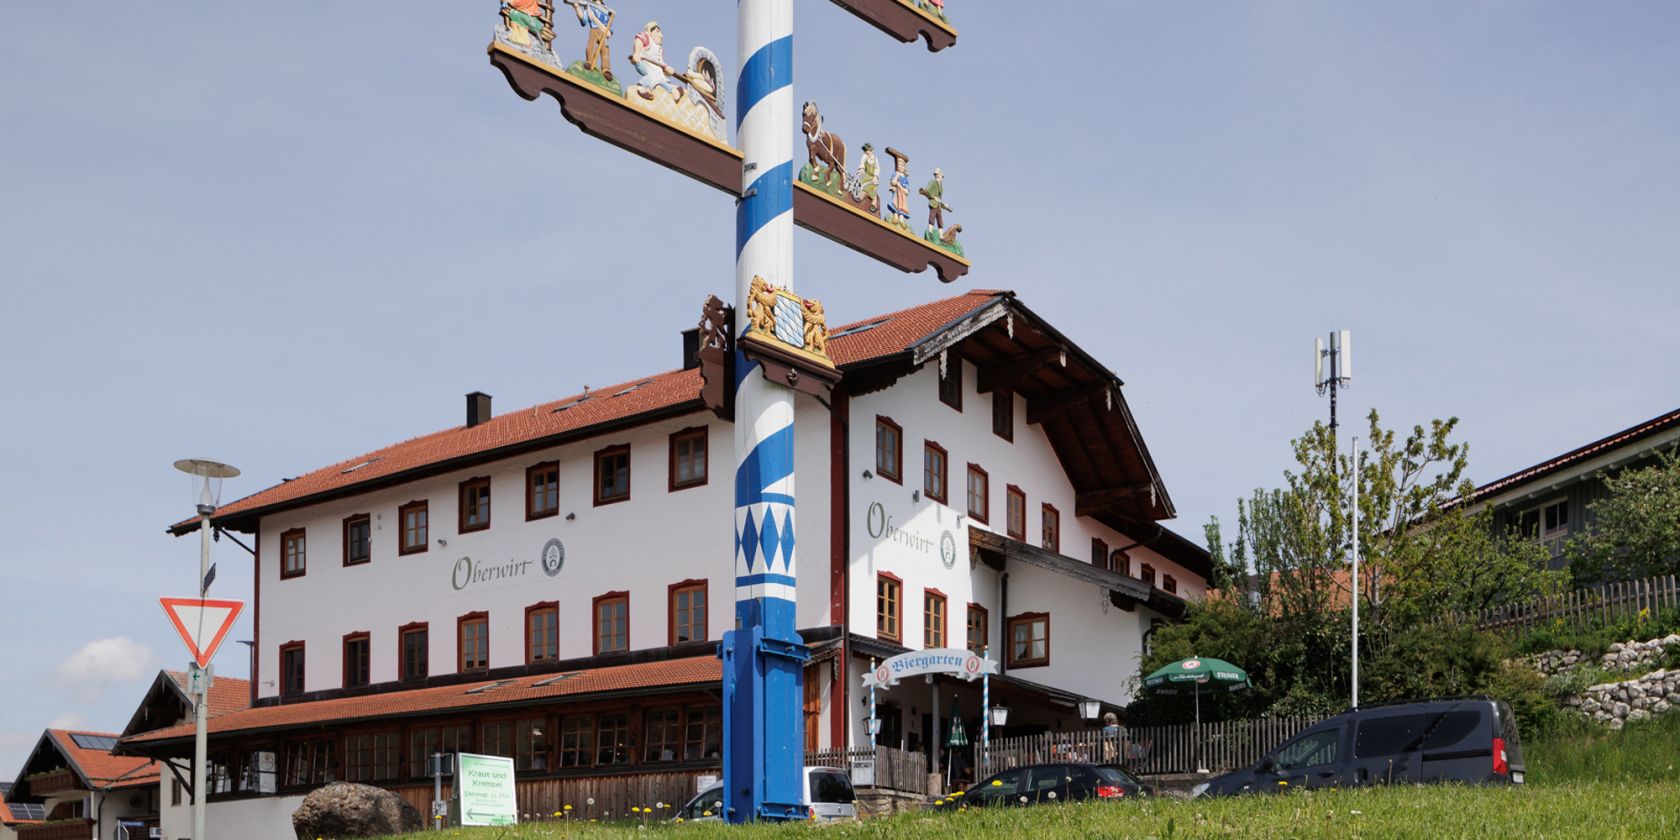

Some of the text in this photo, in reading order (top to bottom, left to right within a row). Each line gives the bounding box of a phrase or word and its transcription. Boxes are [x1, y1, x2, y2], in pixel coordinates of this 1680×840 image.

[867, 501, 934, 554] Oberwirt
[452, 556, 533, 591] Oberwirt
[892, 654, 963, 672] Biergarten
[468, 769, 507, 779] Kraut und
[472, 780, 503, 788] Krempel
